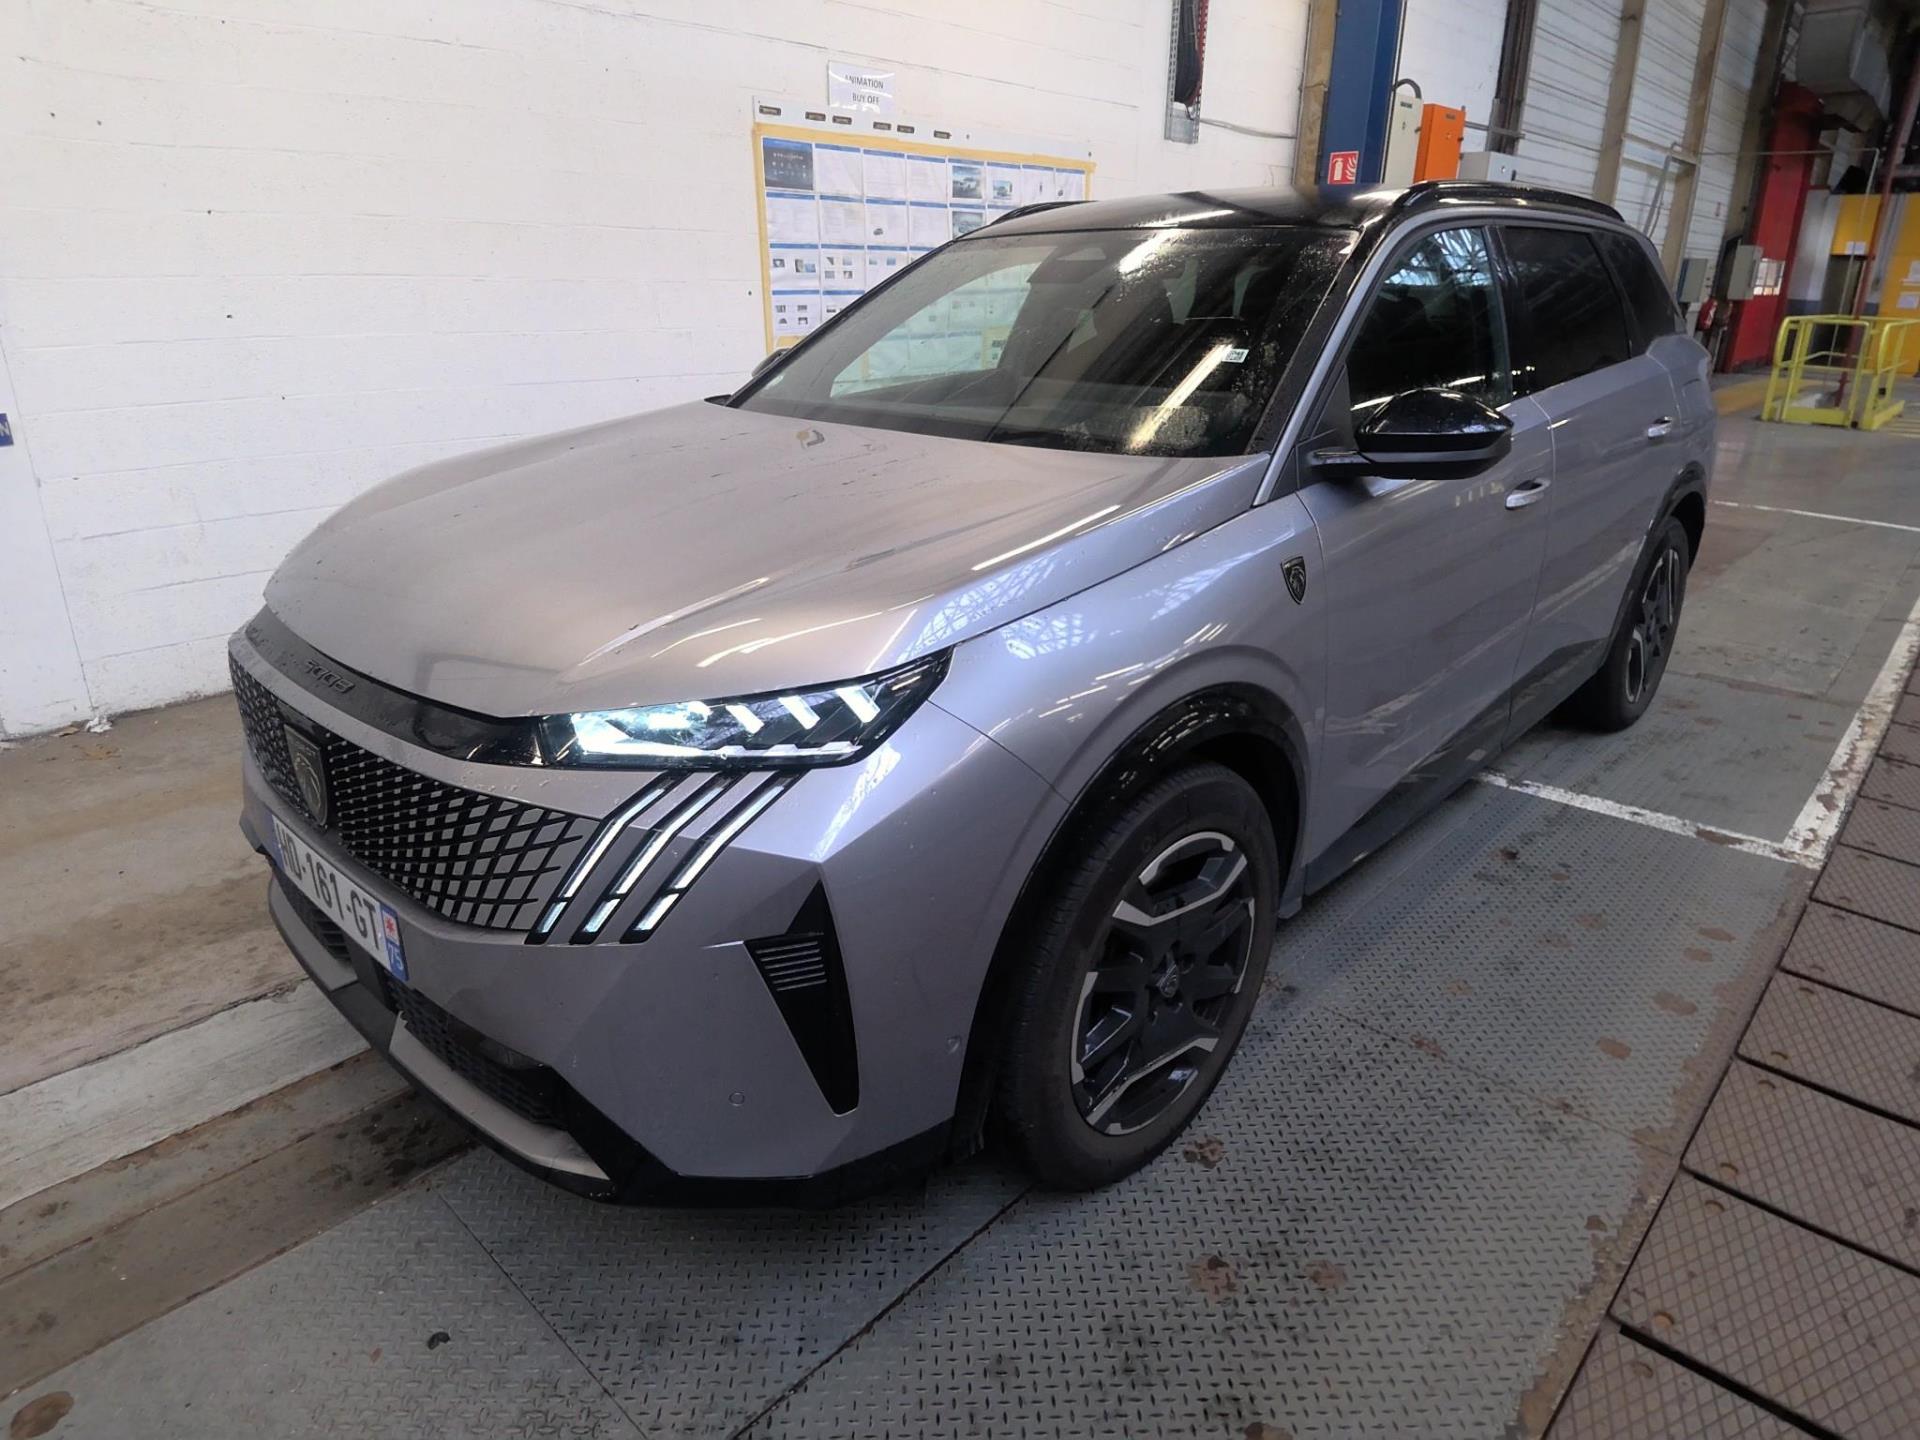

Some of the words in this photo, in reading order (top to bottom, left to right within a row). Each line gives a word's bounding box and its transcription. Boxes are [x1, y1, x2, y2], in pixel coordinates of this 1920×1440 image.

[845, 74, 884, 89] ANIMATION
[852, 92, 866, 103] BUY
[866, 95, 880, 104] OFF
[387, 943, 404, 972] 75
